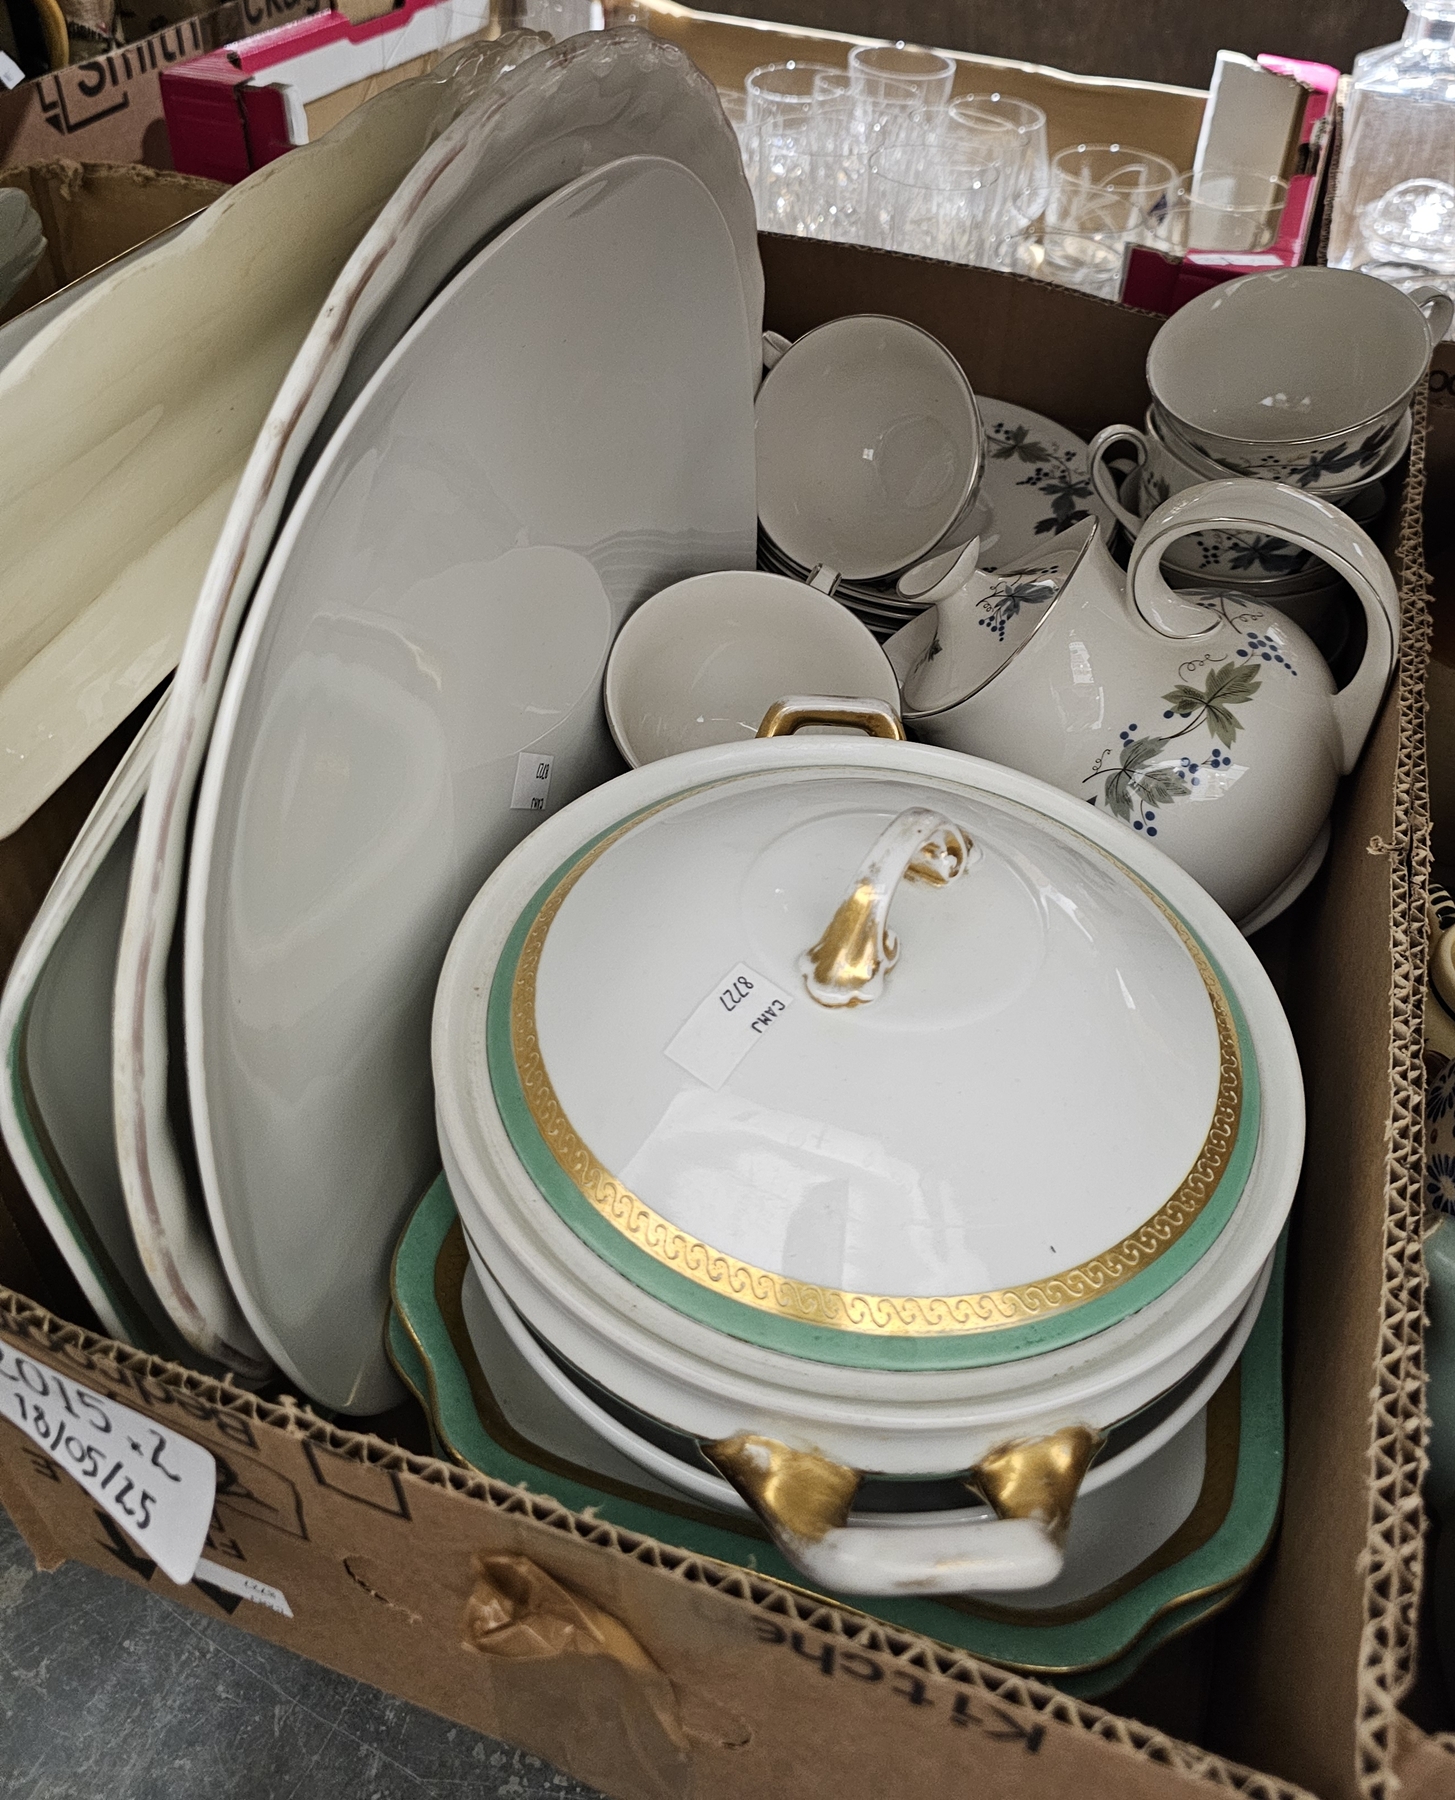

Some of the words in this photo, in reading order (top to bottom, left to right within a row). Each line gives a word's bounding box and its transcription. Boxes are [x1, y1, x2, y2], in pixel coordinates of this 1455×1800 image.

[719, 975, 755, 1012] 8727
[750, 999, 786, 1034] CAMJ
[14, 1392, 157, 1524] 18/05/25
[748, 1613, 1047, 1753] Kitche
